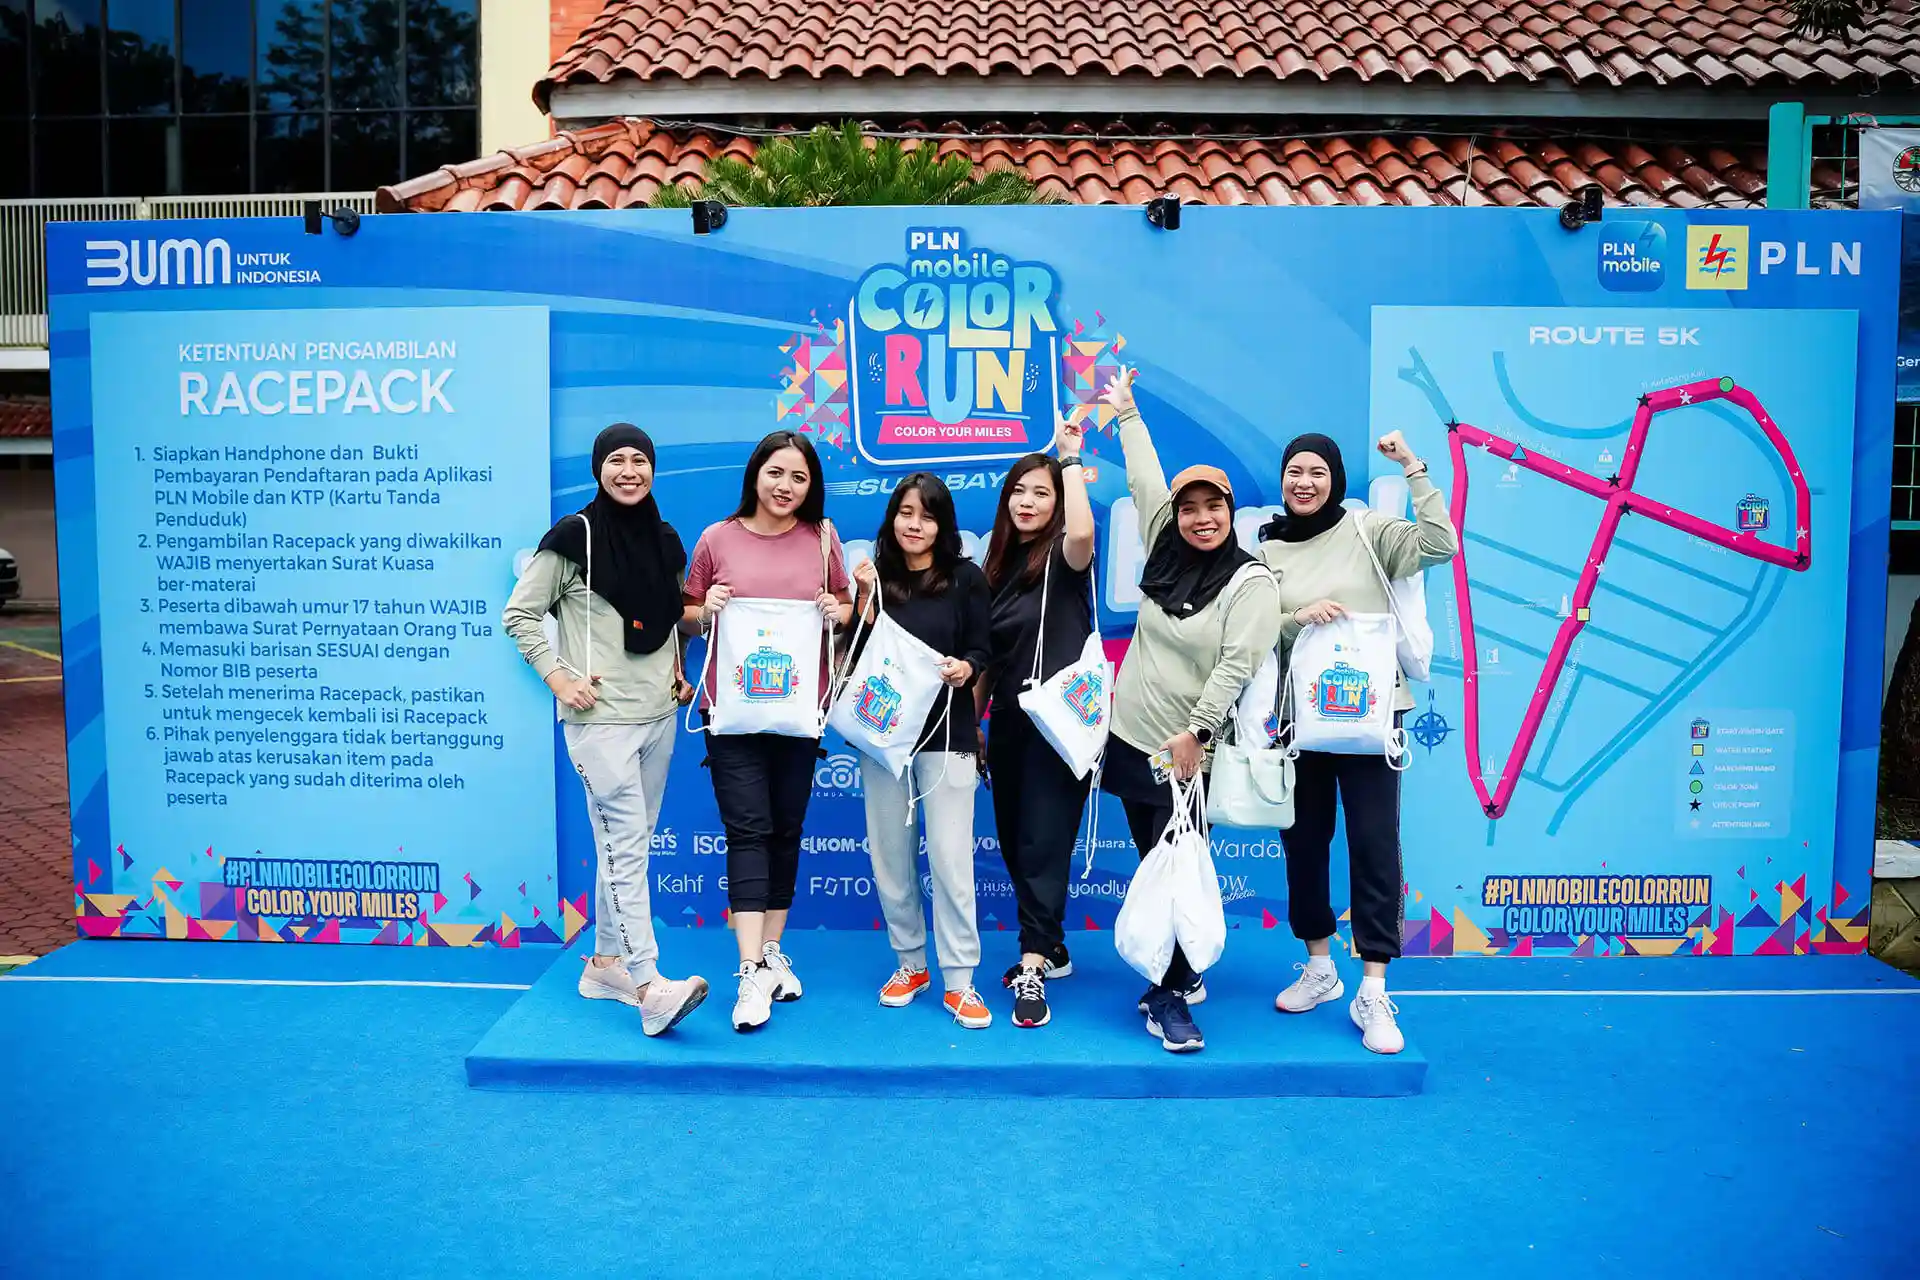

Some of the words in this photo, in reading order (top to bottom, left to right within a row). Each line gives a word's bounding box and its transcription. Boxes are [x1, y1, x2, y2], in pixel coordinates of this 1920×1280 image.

[911, 232, 959, 250] PLN
[1603, 242, 1635, 256] PLN
[86, 238, 231, 286] BUMN
[236, 253, 291, 265] UNTUK
[911, 253, 1010, 278] mobile
[1603, 257, 1660, 273] mobile
[1760, 242, 1861, 275] PLN
[237, 270, 321, 283] INDONESIA
[859, 265, 1057, 348] COLOR
[1530, 326, 1644, 345] ROUTE
[1658, 326, 1700, 345] 5K
[179, 343, 296, 362] KETENTUAN
[305, 340, 456, 361] PENGAMBILAN
[885, 333, 1026, 424] RUN
[179, 368, 456, 416] RACEPACK
[894, 426, 936, 437] COLOR
[939, 426, 972, 437] YOUR
[975, 426, 1012, 437] MILES
[135, 447, 145, 461] 1.
[153, 445, 219, 463] Siapkan
[225, 445, 325, 463] Handphone
[330, 445, 363, 460] dan
[373, 445, 418, 460] Bukti
[155, 468, 258, 486] Pembayaran
[264, 467, 370, 483] Pendaftaran
[376, 466, 418, 486] pada
[424, 466, 492, 485] Aplikasi
[856, 472, 1006, 496] SUBAY
[155, 490, 187, 505] PLN
[192, 489, 248, 504] Mobile
[252, 489, 286, 504] dan
[291, 490, 324, 504] KTP
[329, 488, 381, 507] (Kartu
[386, 488, 440, 504] Tanda
[156, 511, 246, 528] Penduduk)
[138, 534, 151, 548] 2.
[157, 533, 268, 552] Pengambilan
[273, 533, 356, 553] Racepack
[360, 537, 401, 552] yang
[407, 532, 501, 549] diwakilkan
[156, 556, 210, 572] WAJIB
[216, 555, 327, 574] menyertakan
[332, 556, 377, 571] Surat
[383, 556, 434, 571] Kuasa
[158, 576, 255, 592] ber-materai
[140, 598, 154, 612] 3.
[159, 599, 219, 613] Peserta
[224, 598, 297, 614] dibawah
[302, 602, 349, 614] umur
[353, 600, 370, 614] 17
[374, 599, 425, 615] tahun
[429, 600, 487, 615] WAJIB
[160, 620, 248, 635] membawa
[253, 621, 298, 635] Surat
[303, 621, 398, 639] Pernyataan
[404, 622, 456, 640] Orang
[461, 622, 492, 637] Tua
[142, 642, 155, 655] 4.
[160, 641, 245, 657] Memasuki
[251, 641, 311, 657] barisan
[316, 643, 379, 658] SESUAI
[384, 643, 449, 662] dengan
[161, 663, 218, 677] Nomor
[223, 664, 250, 678] BIB
[256, 665, 317, 682] peserta
[145, 684, 157, 698] 5.
[162, 684, 223, 700] Setelah
[229, 684, 314, 700] menerima
[320, 686, 408, 704] Racepack,
[411, 687, 484, 705] pastikan
[1428, 688, 1435, 701] N
[163, 705, 212, 722] untuk
[216, 706, 304, 724] mengecek
[309, 707, 376, 724] kembali
[382, 708, 398, 723] isi
[404, 709, 488, 728] Racepack
[146, 726, 159, 740] 6.
[164, 726, 210, 743] Pihak
[215, 728, 338, 750] penyelenggara
[342, 728, 386, 744] tidak
[391, 729, 503, 750] bertanggung
[163, 748, 214, 767] jawab
[218, 750, 252, 765] atas
[257, 749, 341, 765] kerusakan
[347, 750, 385, 767] item
[391, 752, 433, 770] pada
[166, 769, 245, 787] Racepack
[249, 772, 289, 789] yang
[294, 772, 345, 787] sudah
[350, 771, 422, 788] diterima
[428, 773, 464, 789] oleh
[167, 792, 227, 807] peserta
[1090, 838, 1126, 848] Suara
[226, 860, 437, 892] #PLNMOBILECOLORRUN
[657, 874, 704, 893] Kahf
[810, 877, 877, 896] FOTO
[1068, 880, 1126, 898] yondly
[1485, 878, 1709, 905] #PLNMOBILECOLORRUN
[247, 889, 304, 915] COLOR
[308, 891, 358, 917] YOUR
[361, 892, 417, 918] MILES
[1506, 906, 1570, 933] COLOR
[1571, 906, 1624, 933] YOUR
[1628, 906, 1688, 933] MILES
